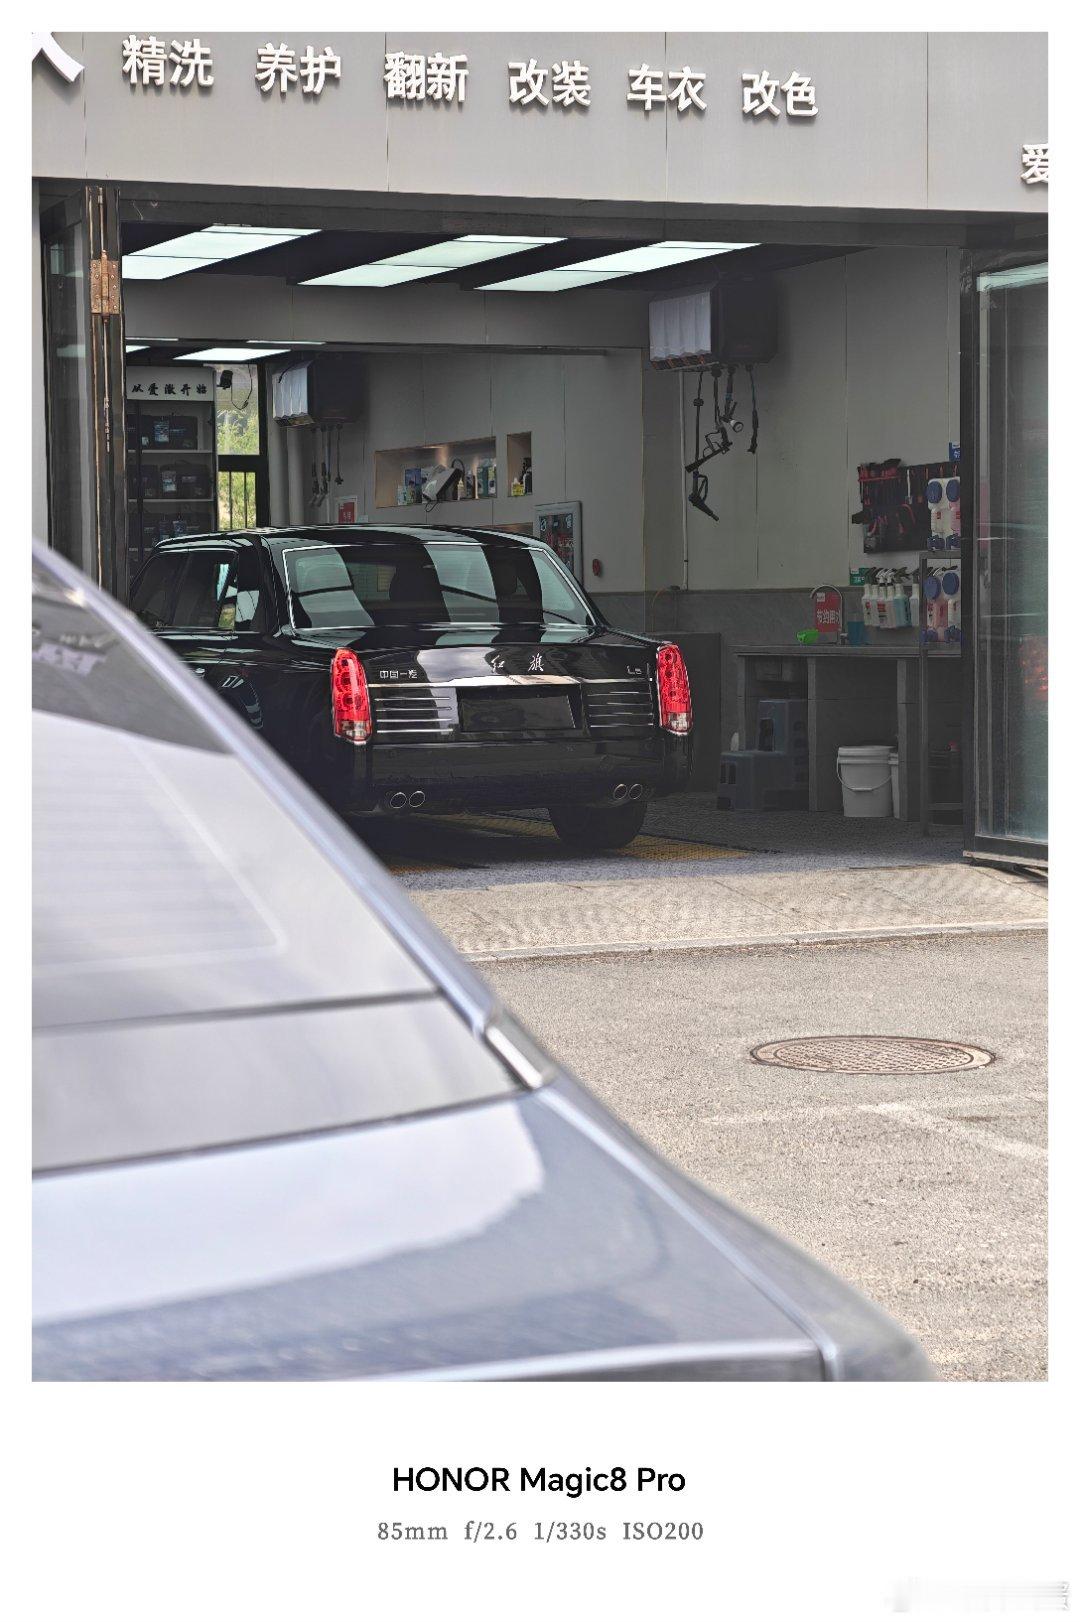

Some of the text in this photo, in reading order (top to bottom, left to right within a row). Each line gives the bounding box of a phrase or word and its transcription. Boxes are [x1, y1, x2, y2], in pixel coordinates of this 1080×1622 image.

[122, 34, 214, 88] 精洗
[255, 42, 341, 94] 养护
[383, 51, 469, 102] 翻新
[508, 59, 592, 107] 改装
[626, 63, 708, 112] 车衣
[741, 69, 819, 117] 改色
[490, 652, 545, 673] 红旗
[379, 669, 418, 679] 中国一汽
